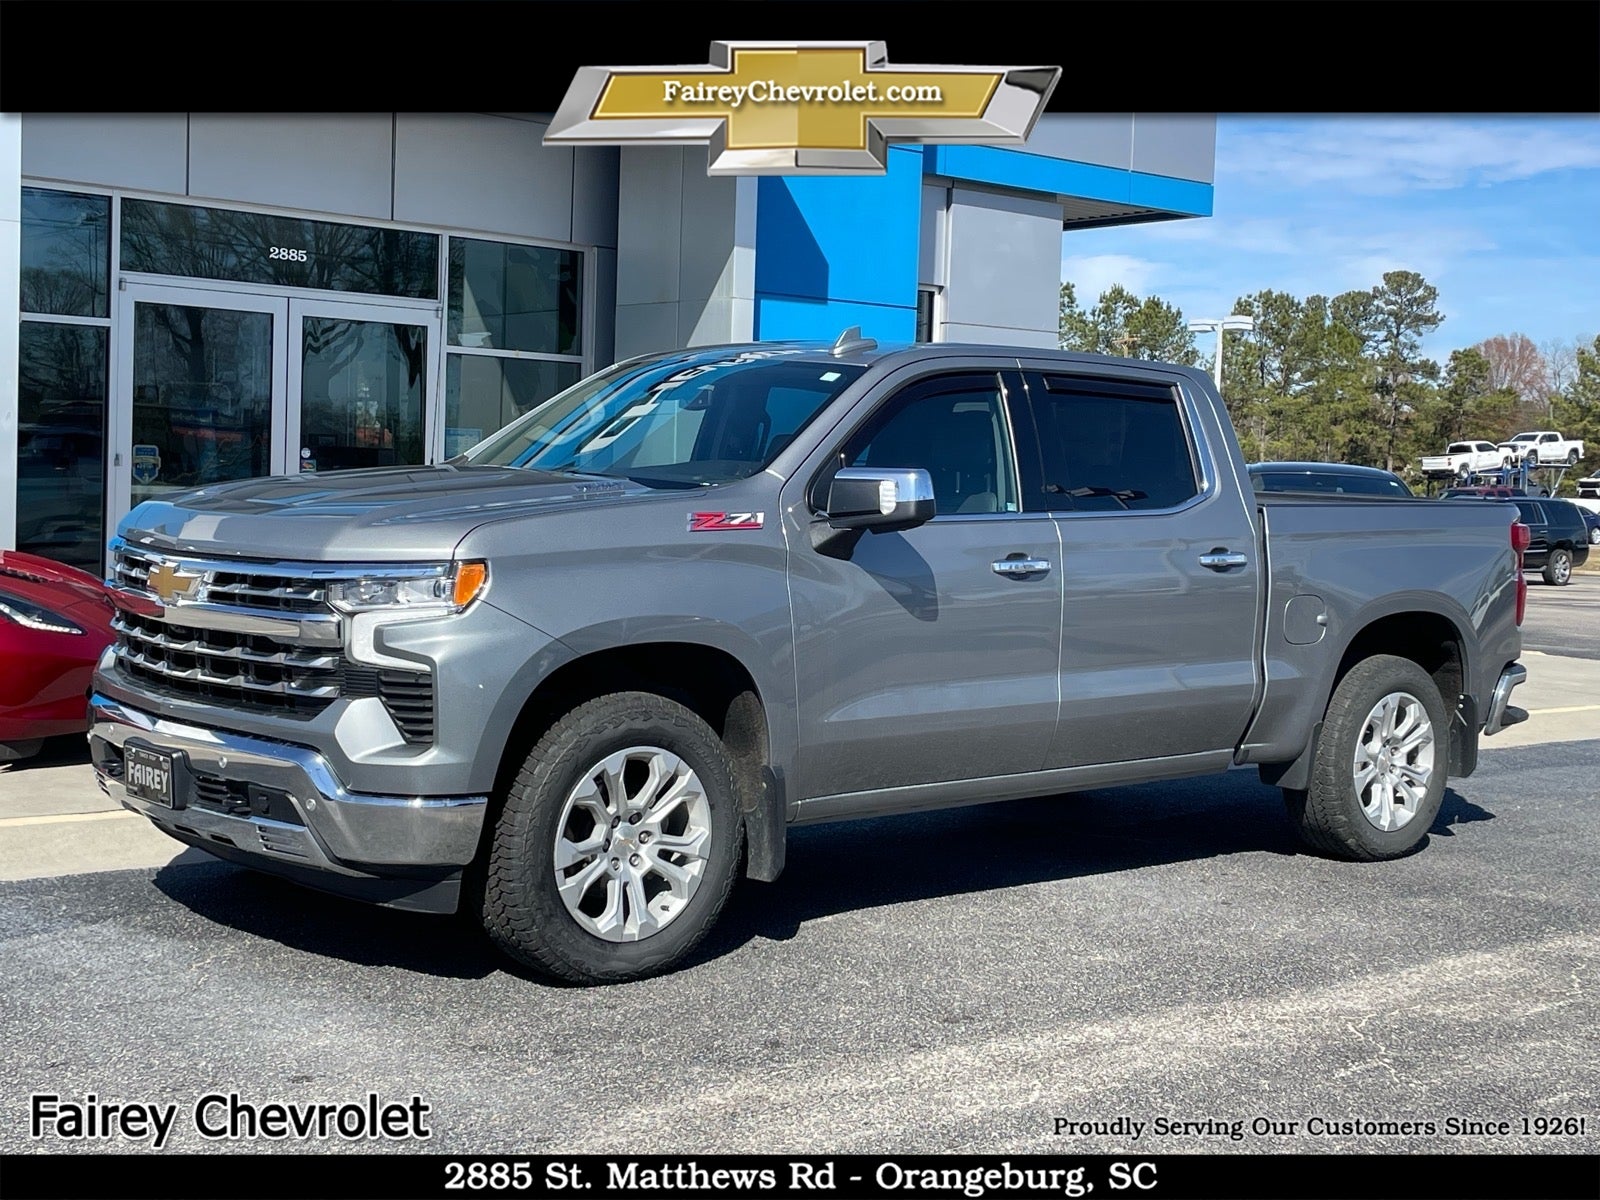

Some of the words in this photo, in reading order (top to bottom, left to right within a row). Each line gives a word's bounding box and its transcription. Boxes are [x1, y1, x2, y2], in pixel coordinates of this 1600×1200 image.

[269, 246, 308, 262] 2885
[687, 511, 765, 532] Z71
[127, 761, 169, 794] FAIREY
